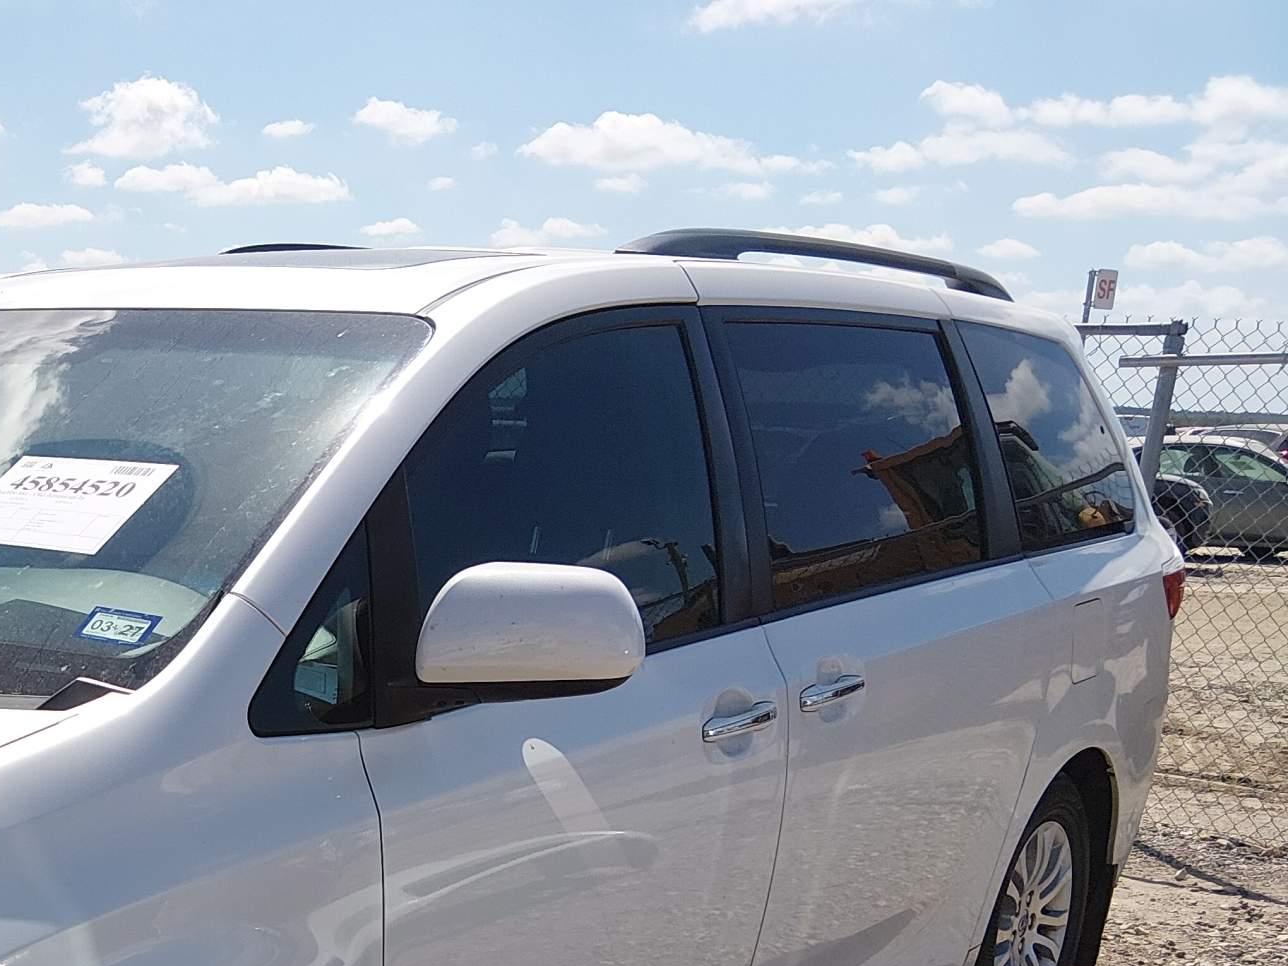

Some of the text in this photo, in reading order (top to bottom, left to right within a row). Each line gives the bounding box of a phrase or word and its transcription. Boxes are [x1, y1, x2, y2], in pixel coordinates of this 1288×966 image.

[1097, 279, 1116, 300] SF
[9, 474, 137, 498] 45854520
[90, 619, 114, 633] 03
[118, 624, 145, 637] 27
